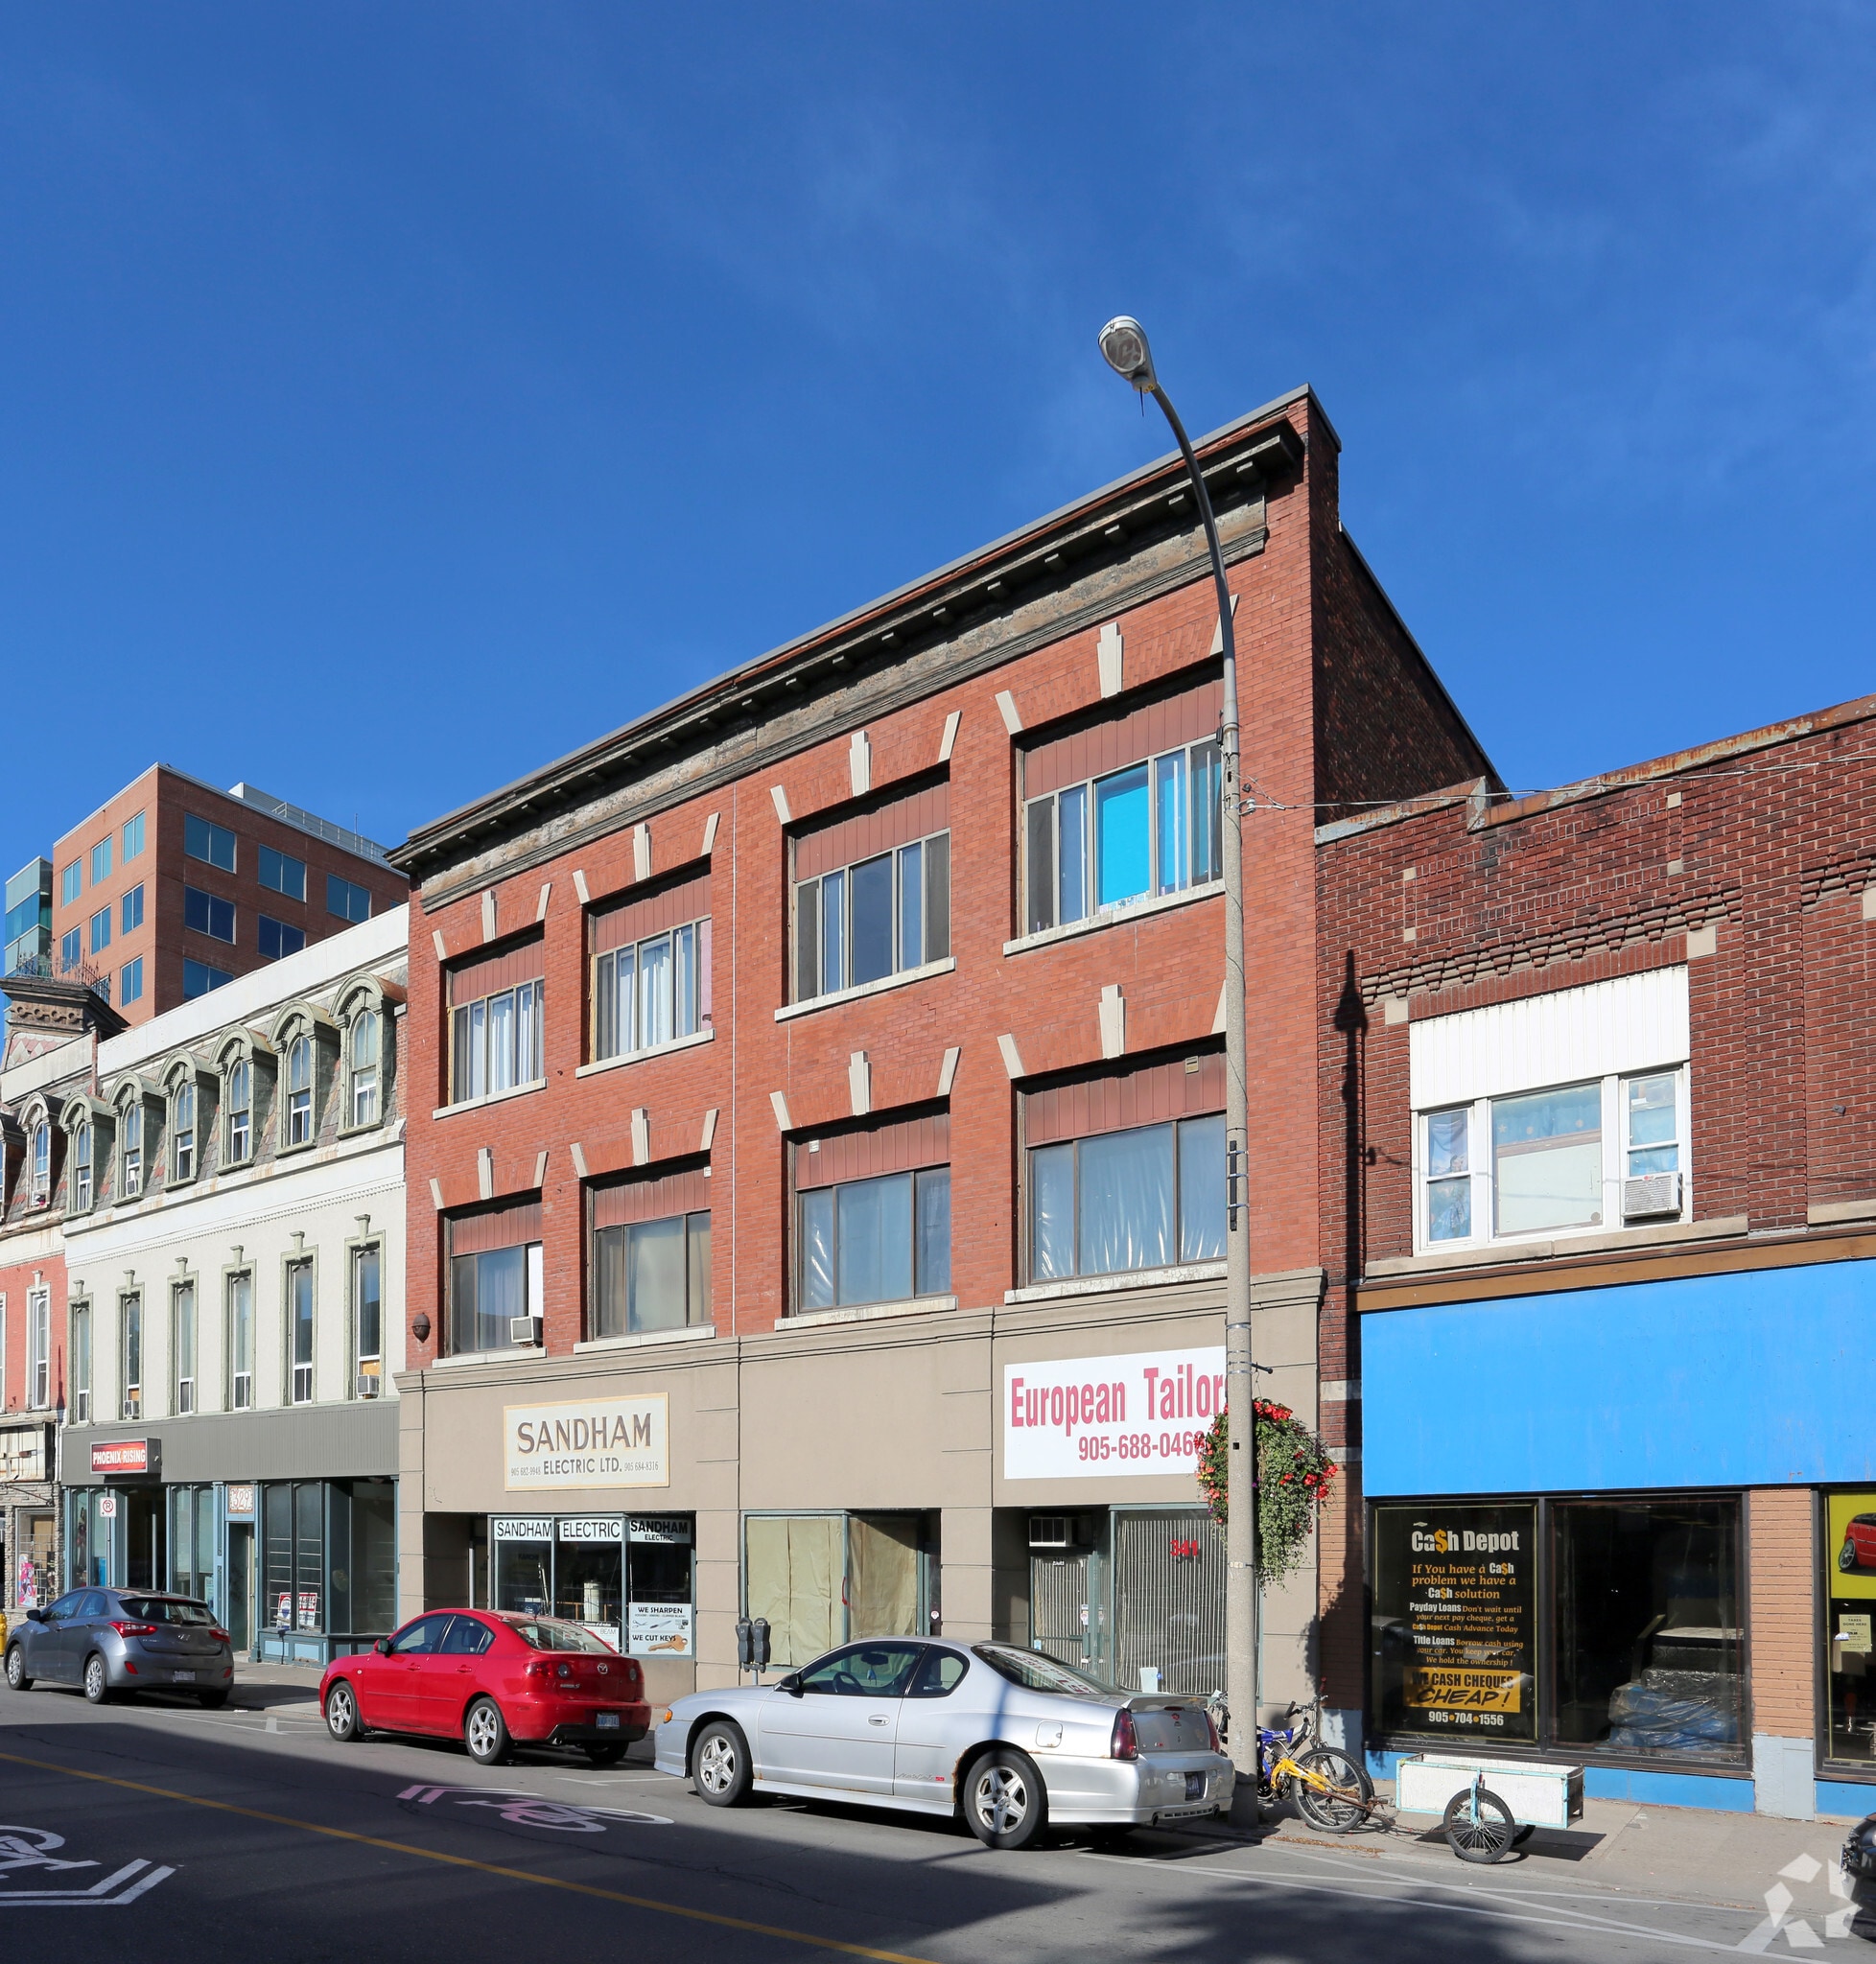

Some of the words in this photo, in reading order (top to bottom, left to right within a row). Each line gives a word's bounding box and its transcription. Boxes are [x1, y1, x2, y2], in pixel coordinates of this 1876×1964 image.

[1011, 1377, 1126, 1437] European
[1143, 1363, 1228, 1421] Tailor
[517, 1412, 652, 1454] SANDHAM
[92, 1450, 122, 1465] PHOENIX
[122, 1449, 146, 1463] RISING
[510, 1467, 520, 1477] 905
[543, 1458, 596, 1475] ELECTRIC
[599, 1457, 622, 1473] LTD.
[623, 1462, 634, 1471] 905
[497, 1521, 552, 1537] SANDHAM
[563, 1521, 621, 1538] ELECTRIC
[630, 1519, 688, 1534] SANDHAM
[1169, 1539, 1198, 1556] 341
[1411, 1529, 1459, 1554] Ca$h
[1463, 1530, 1519, 1553] Depot
[1412, 1564, 1422, 1574] If
[1424, 1564, 1445, 1574] You
[1449, 1563, 1476, 1574] have
[1478, 1565, 1486, 1574] a
[1489, 1562, 1514, 1575] Ca$h
[1412, 1575, 1457, 1587] problem
[1479, 1575, 1506, 1585] have
[1428, 1587, 1453, 1600] Ca$h
[1454, 1588, 1500, 1599] solution
[1409, 1602, 1438, 1613] Payday
[1439, 1602, 1462, 1612] Loans
[1496, 1625, 1518, 1634] Today
[1413, 1635, 1431, 1645] Title
[1432, 1635, 1455, 1646] Loans
[1503, 1640, 1524, 1648] using
[1465, 1648, 1483, 1656] keep
[1470, 1658, 1509, 1668] ownership
[1431, 1672, 1462, 1687] CASH
[1464, 1674, 1514, 1689] CHEQUES
